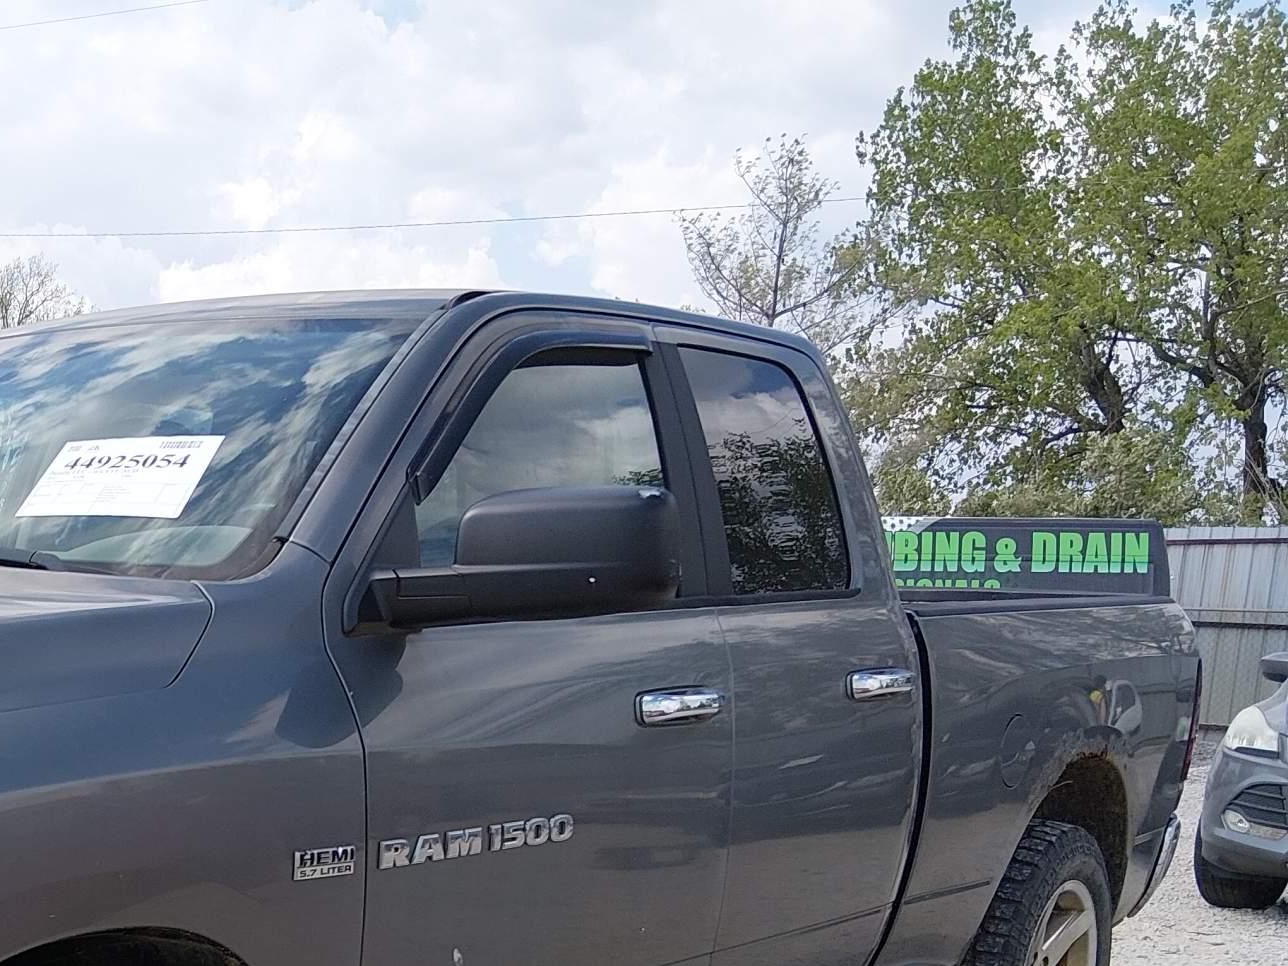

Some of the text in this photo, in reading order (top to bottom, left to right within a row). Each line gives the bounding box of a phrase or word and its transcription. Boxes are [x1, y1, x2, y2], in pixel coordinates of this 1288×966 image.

[65, 454, 191, 469] 44925054
[993, 537, 1021, 572] &
[1031, 532, 1149, 573] DRAIN
[378, 814, 574, 869] RAM 1500
[296, 846, 355, 868] HEMI
[319, 865, 352, 876] LITER
